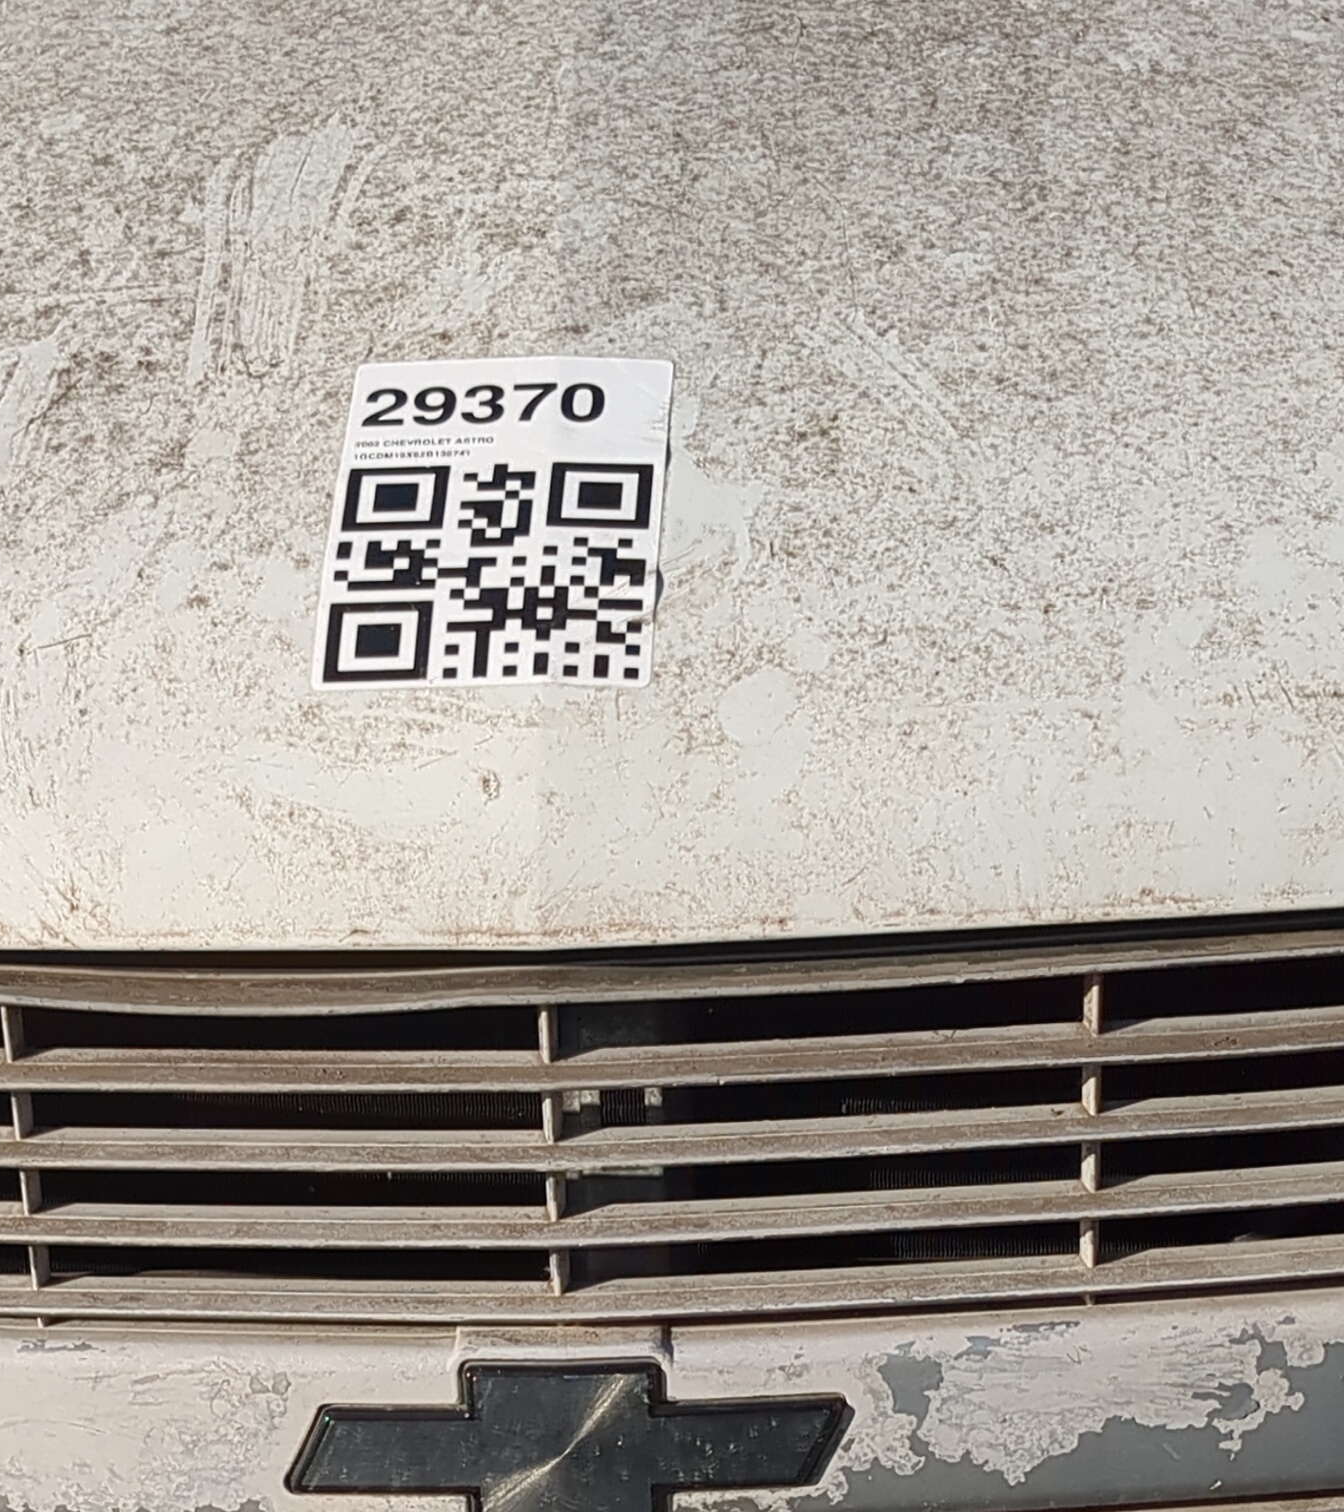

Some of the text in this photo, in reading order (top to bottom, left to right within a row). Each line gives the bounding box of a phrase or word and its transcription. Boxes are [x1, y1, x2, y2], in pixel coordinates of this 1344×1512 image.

[361, 382, 606, 428] 29370
[383, 437, 451, 448] CHEVROLET
[454, 436, 495, 446] ASTRO
